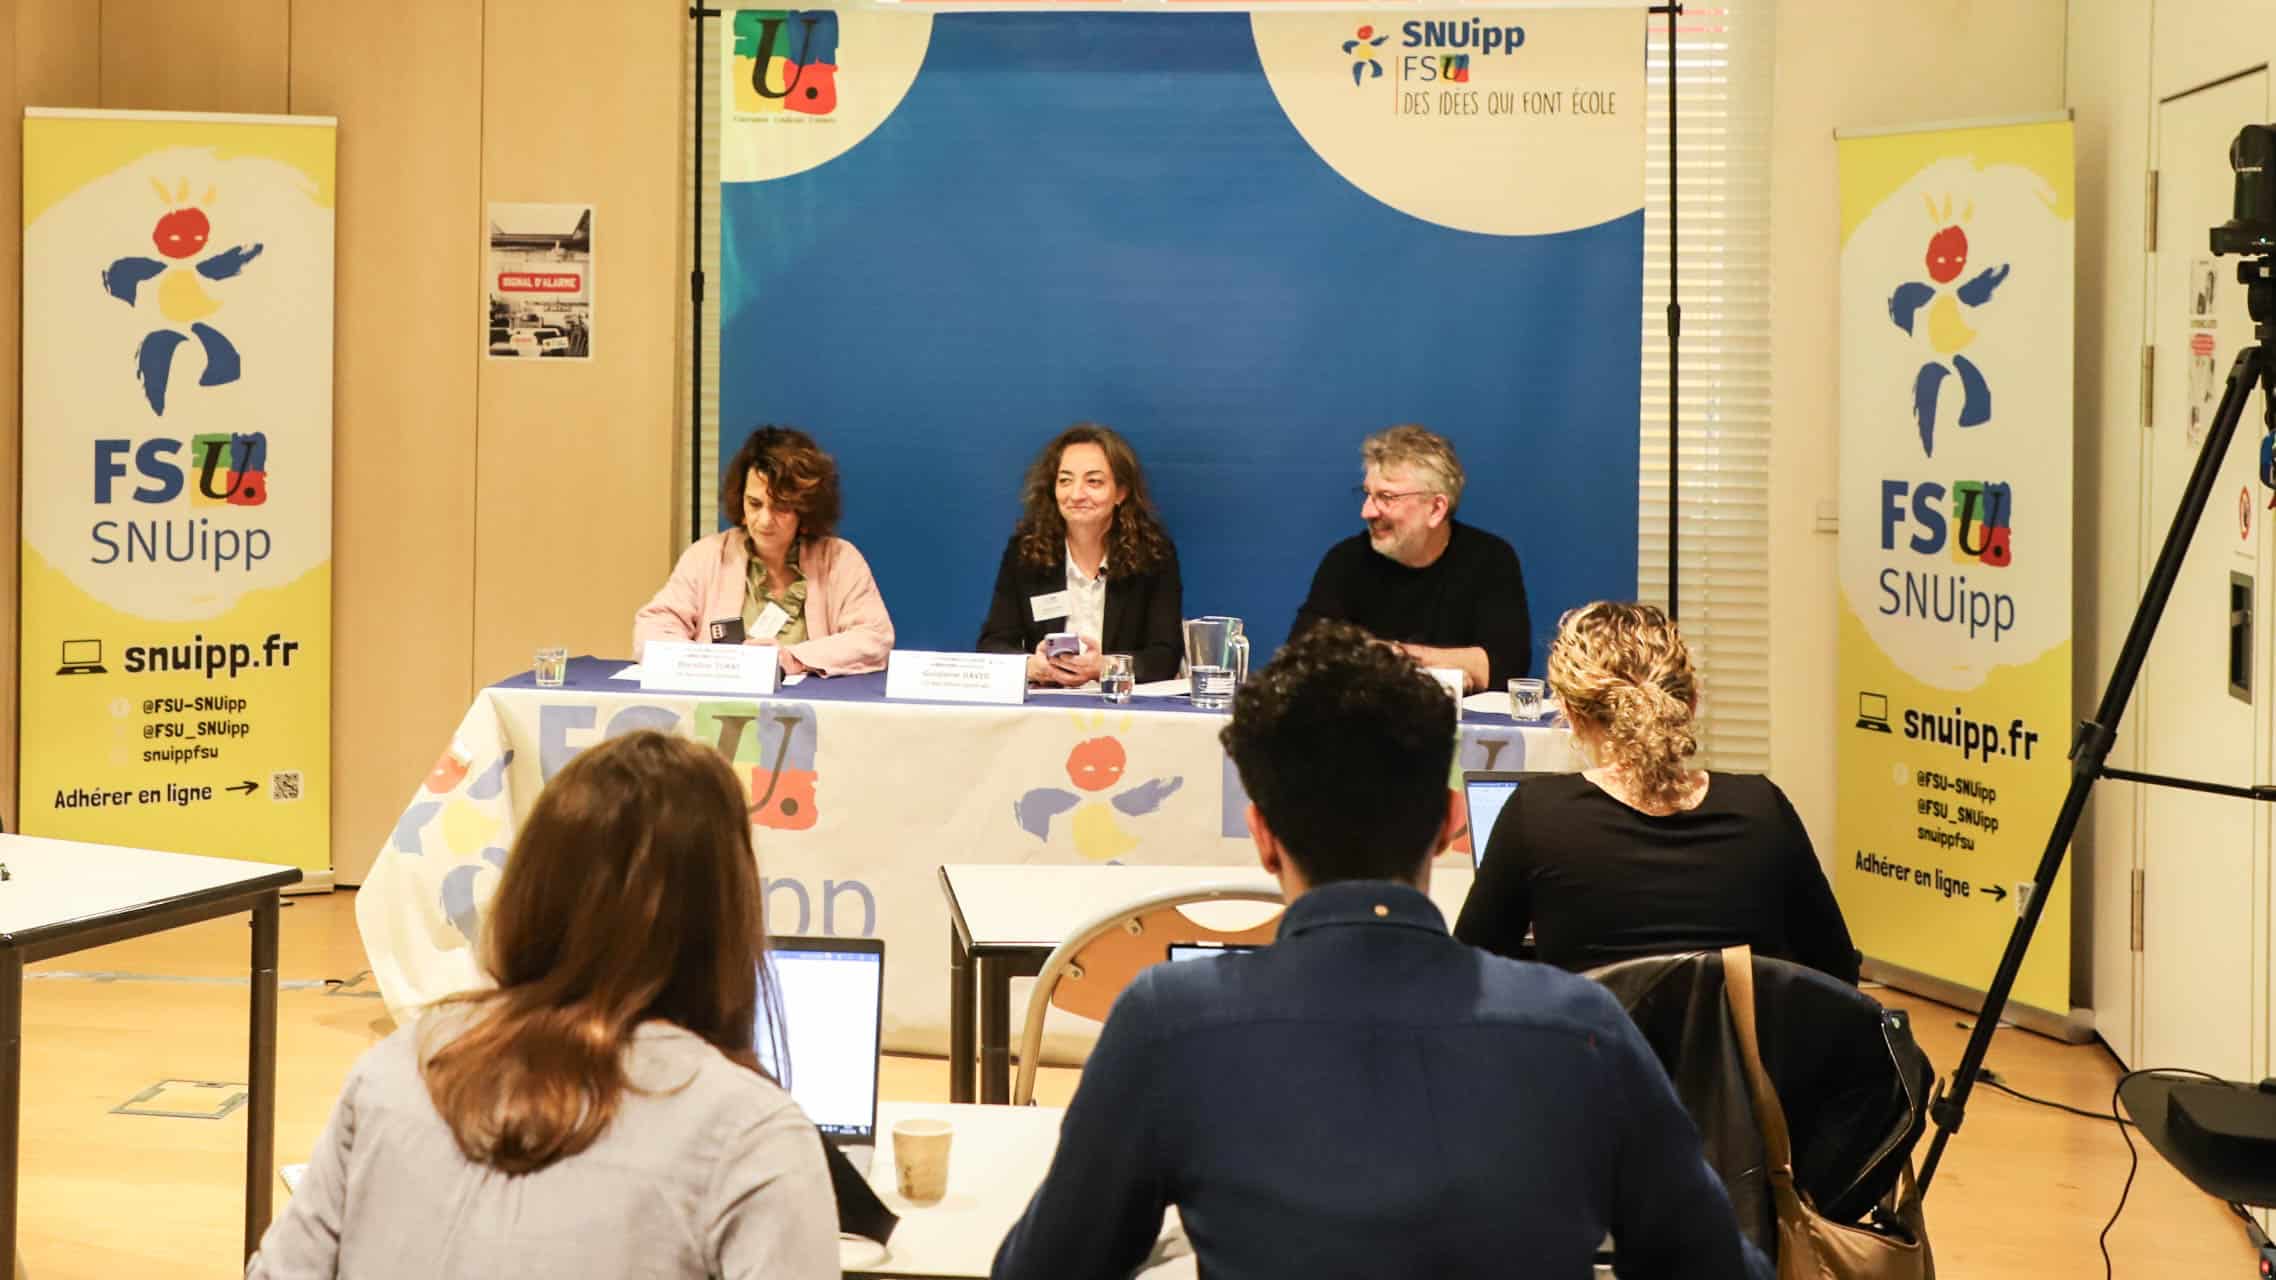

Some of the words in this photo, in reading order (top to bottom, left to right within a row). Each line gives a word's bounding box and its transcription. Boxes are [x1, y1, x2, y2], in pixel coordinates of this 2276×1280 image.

[1402, 17, 1525, 55] SNUipp
[1404, 91, 1430, 115] DES
[1488, 91, 1514, 115] QUI
[1523, 91, 1562, 115] FONT
[1572, 86, 1616, 115] ÉCOLE
[91, 518, 271, 571] SNUipp
[1879, 567, 2015, 643] SNUipp
[124, 634, 299, 678] snuipp.fr
[143, 696, 247, 713] @FSU-SNUipp
[143, 721, 250, 739] @FSU_SNUipp
[1903, 707, 2038, 763] snuipp.fr
[143, 744, 219, 763] snuippfsu
[54, 788, 132, 808] Adhérer
[138, 790, 160, 804] en
[167, 783, 212, 806] ligne
[1917, 770, 1996, 804] @FSU-SNUipp
[1917, 826, 1975, 851] snuippfsu
[1855, 850, 1911, 881] Adhérer
[1914, 868, 1932, 888] en
[1935, 868, 1970, 898] ligne
